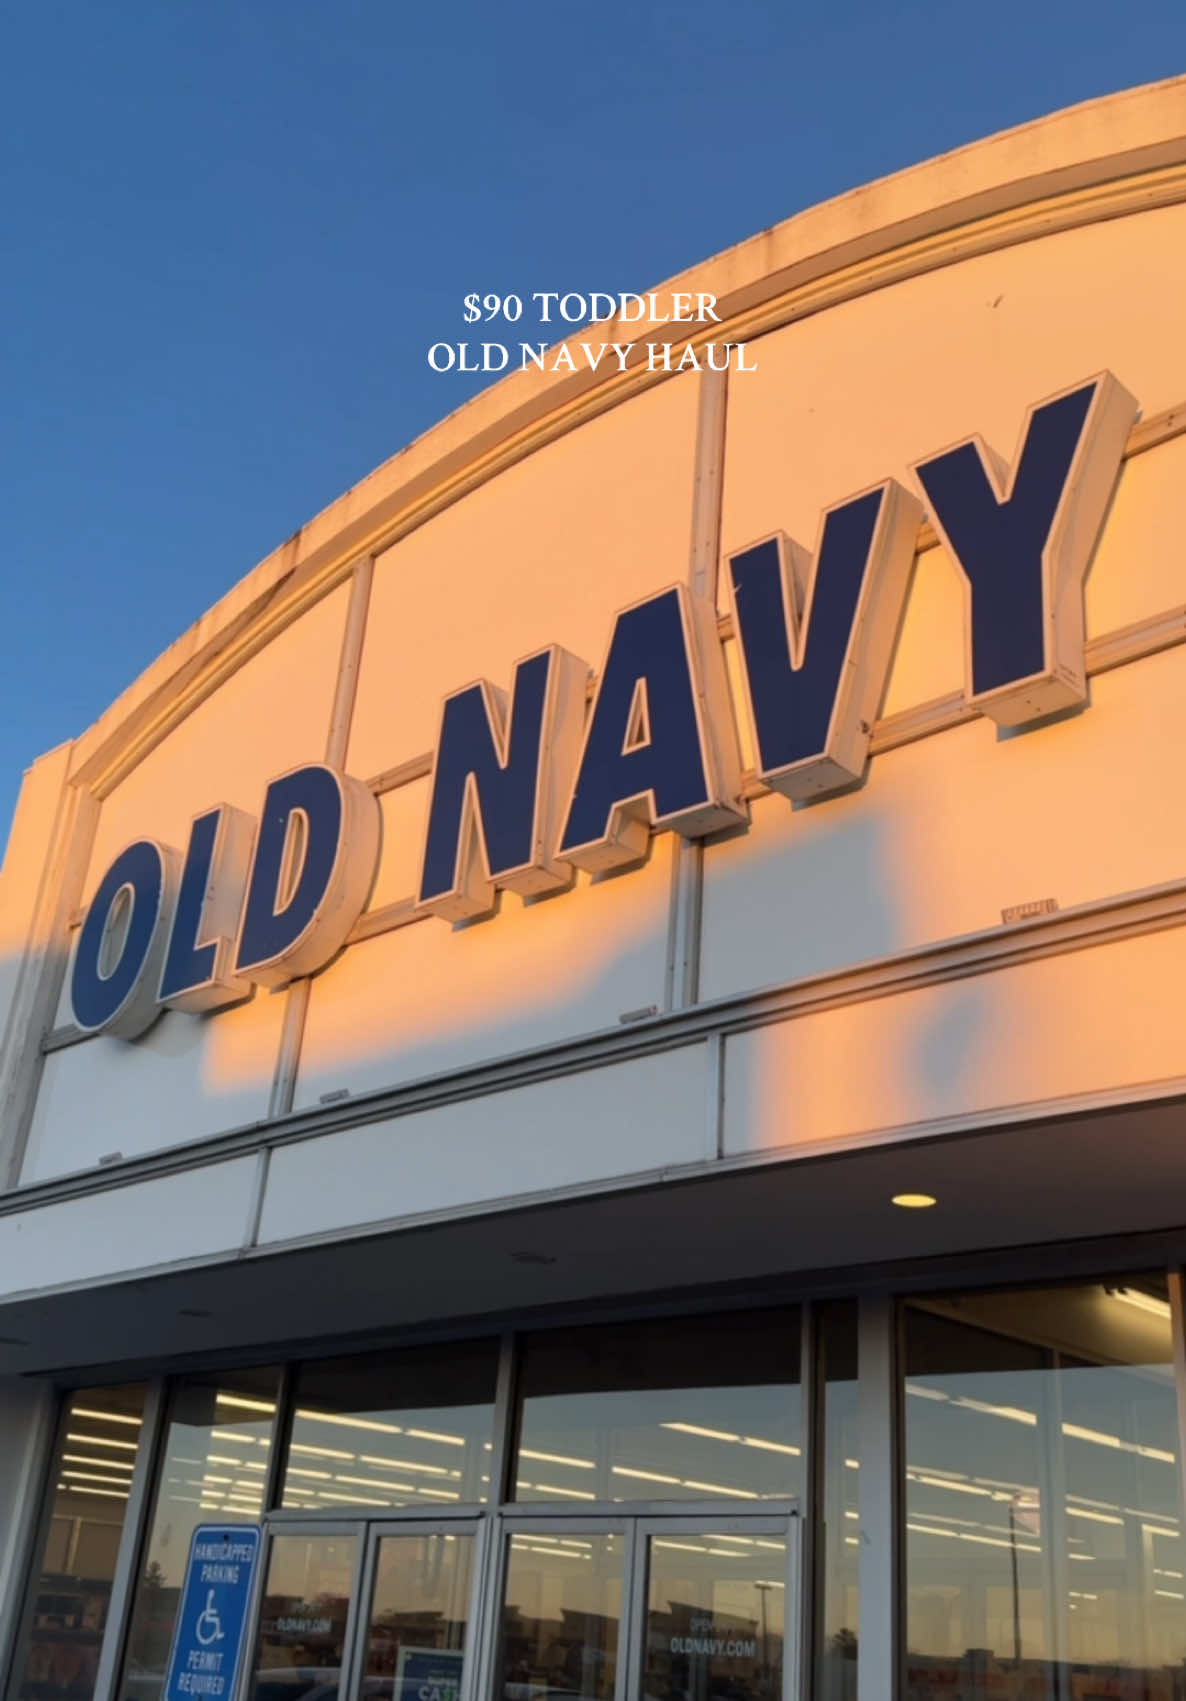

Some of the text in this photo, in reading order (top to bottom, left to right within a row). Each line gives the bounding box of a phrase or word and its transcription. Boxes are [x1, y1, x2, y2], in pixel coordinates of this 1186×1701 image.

[70, 370, 1110, 1033] OLD NAVY
[194, 1543, 254, 1562] HANDICAPPED
[201, 1563, 240, 1584] PARKING
[671, 1637, 756, 1657] OLDNAVY.COM
[187, 1650, 224, 1671] PERMIT
[178, 1672, 225, 1696] REQUIRED
